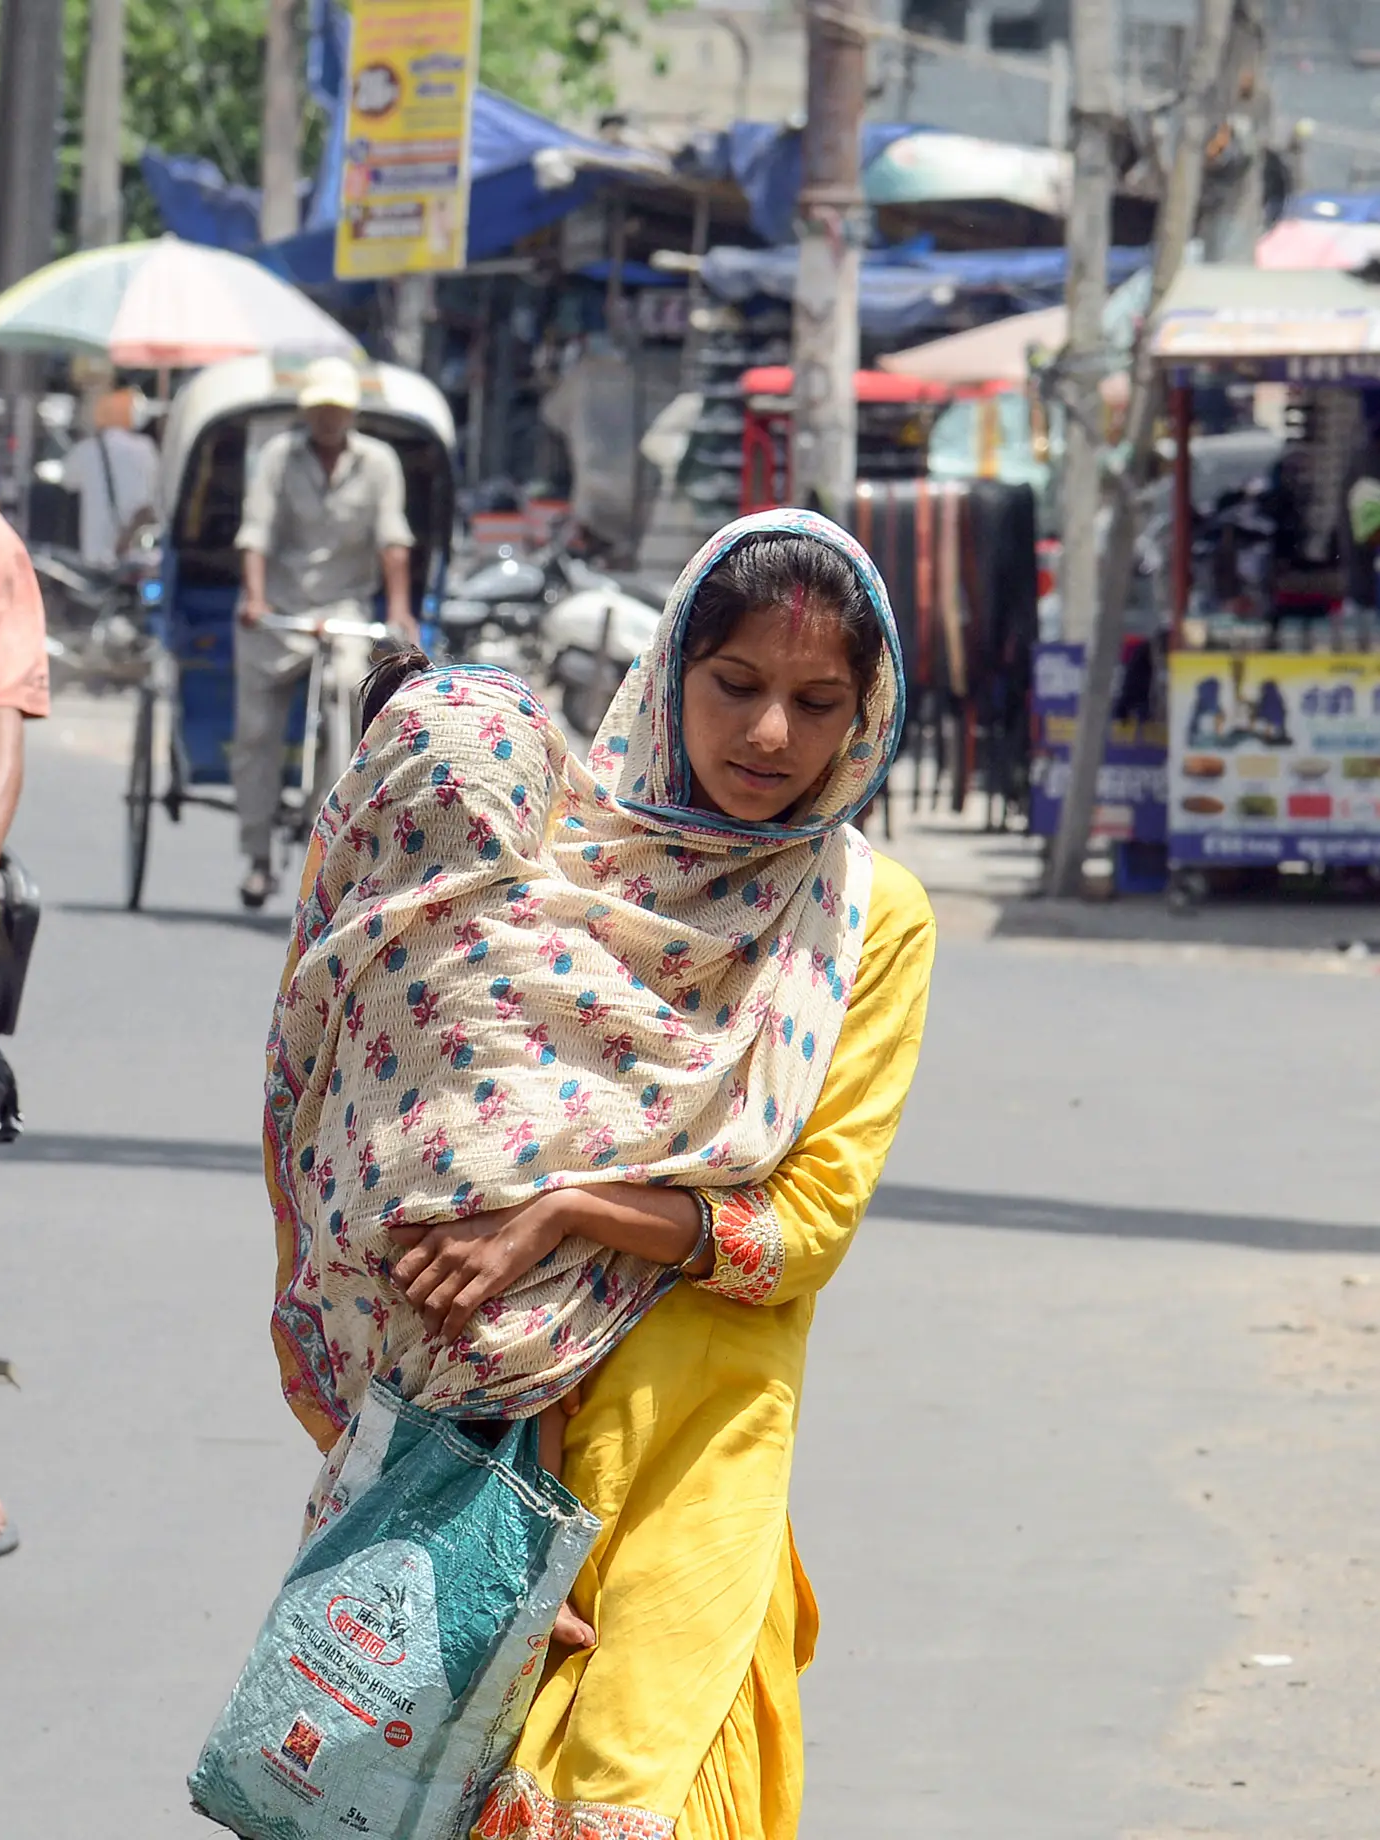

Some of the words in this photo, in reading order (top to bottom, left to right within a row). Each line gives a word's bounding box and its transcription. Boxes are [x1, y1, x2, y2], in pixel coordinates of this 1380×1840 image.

[355, 1607, 385, 1634] बिरला
[291, 1613, 310, 1636] ZINC
[306, 1628, 347, 1668] SULPHATE
[385, 1731, 410, 1742] QUALITY
[347, 1806, 357, 1818] 5
[355, 1811, 368, 1826] kg
